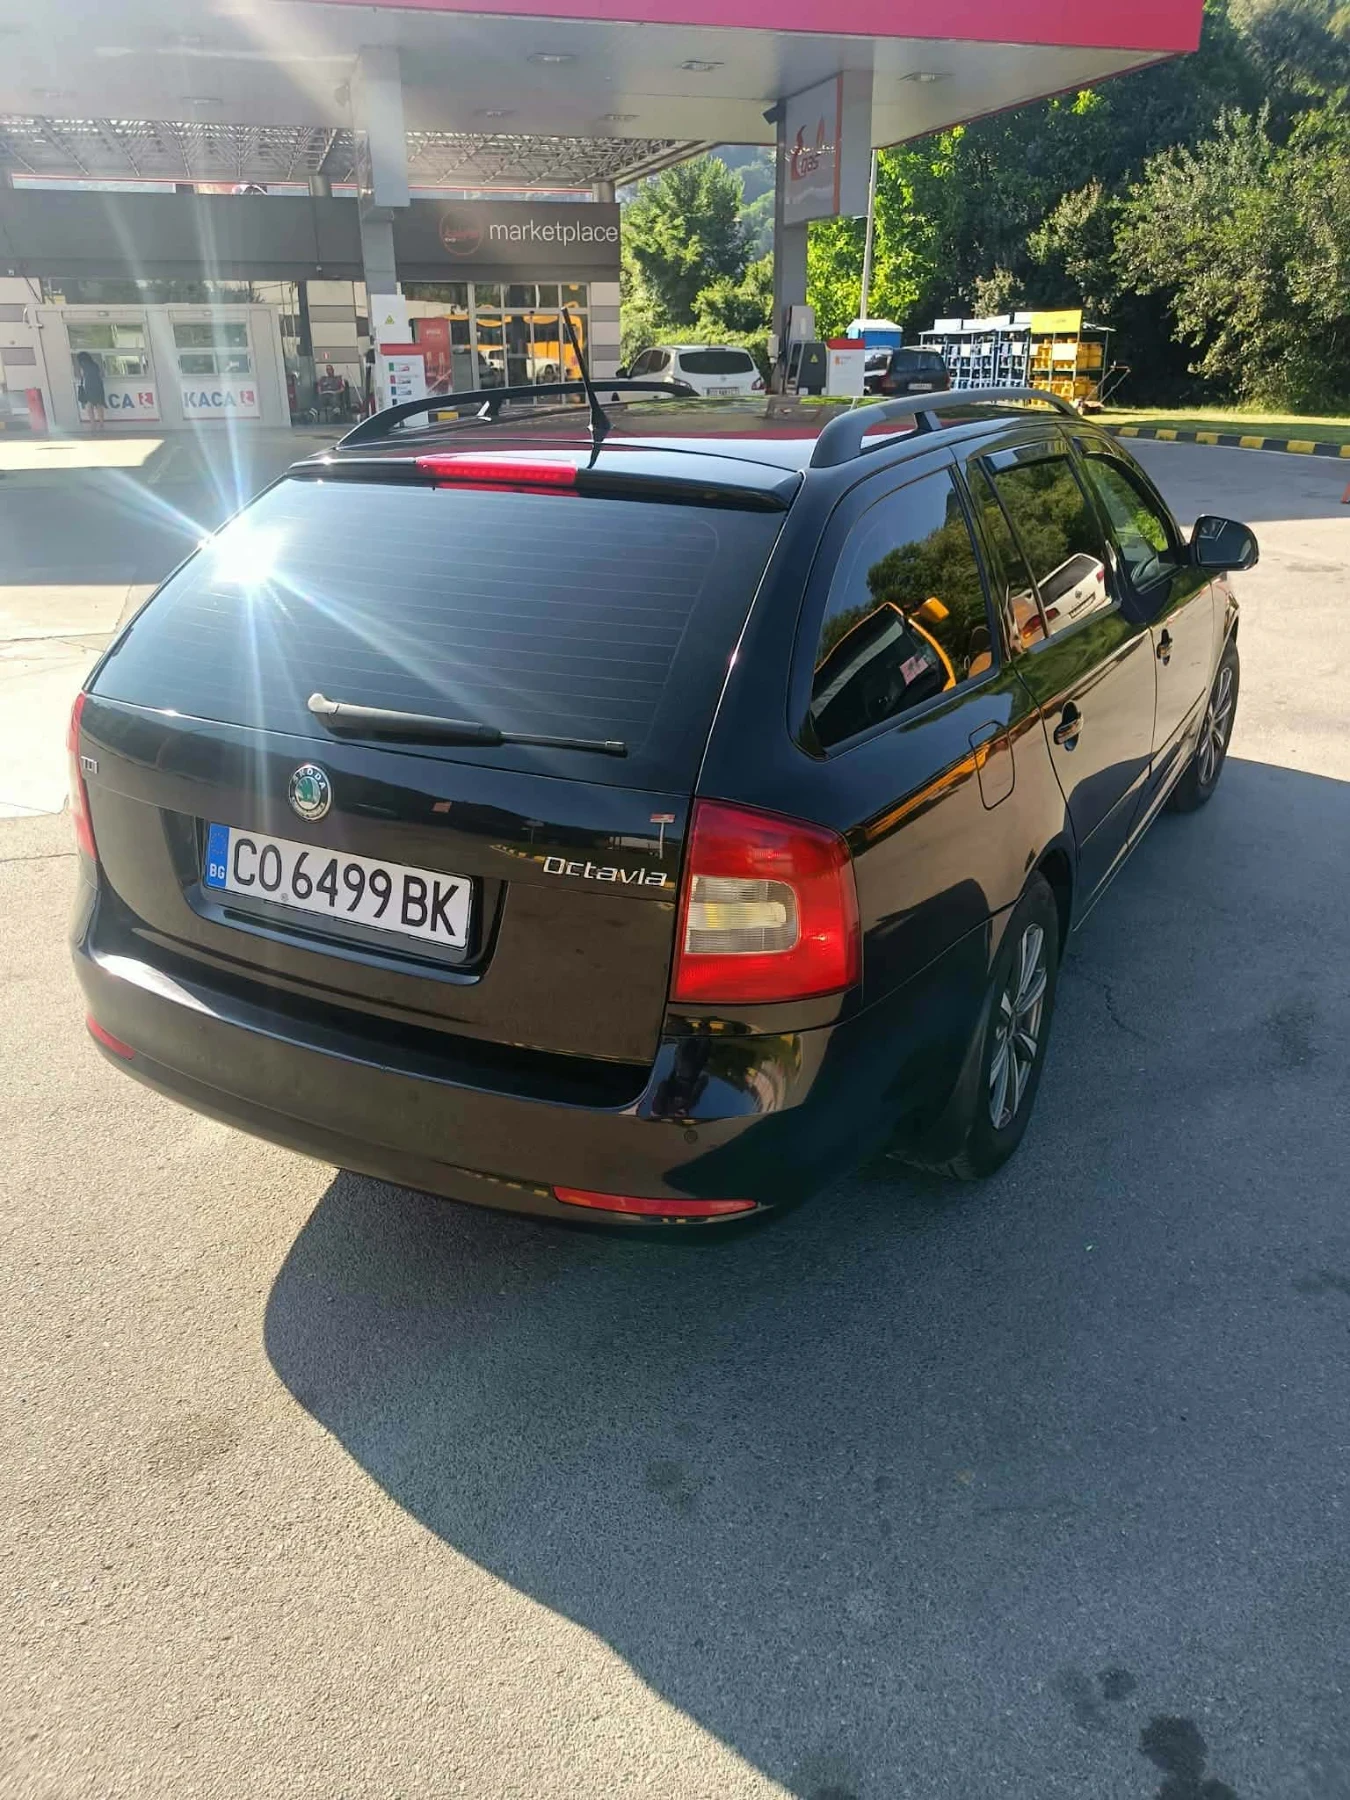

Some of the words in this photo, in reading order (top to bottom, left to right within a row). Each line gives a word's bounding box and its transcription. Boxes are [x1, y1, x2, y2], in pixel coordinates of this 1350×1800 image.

[489, 219, 619, 247] marketplace
[80, 755, 98, 774] TDI
[208, 863, 226, 880] BG
[291, 851, 392, 919] 6499
[543, 856, 668, 887] Octavia
